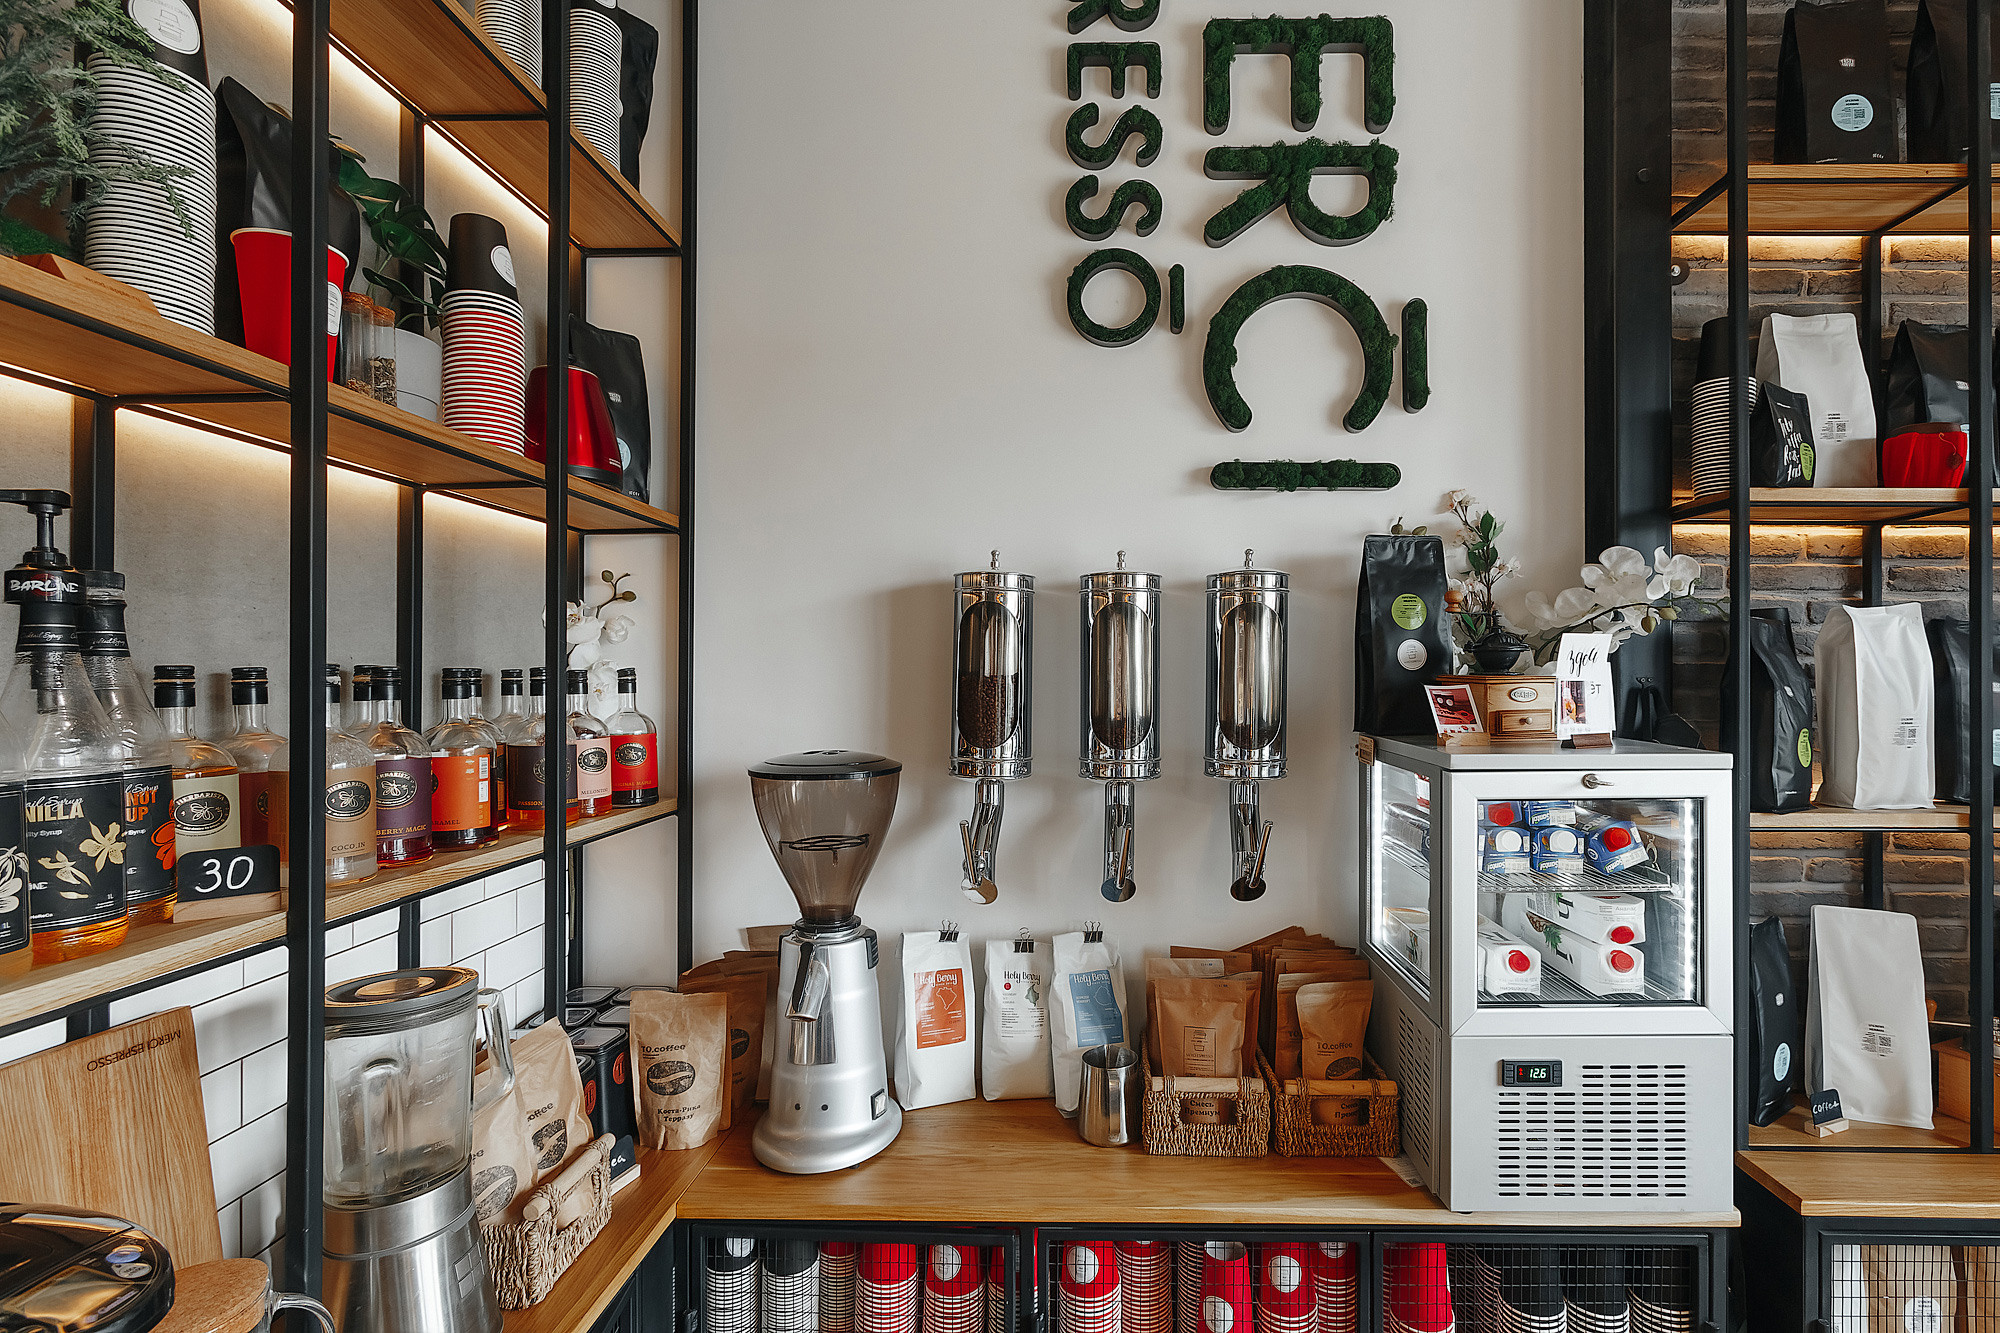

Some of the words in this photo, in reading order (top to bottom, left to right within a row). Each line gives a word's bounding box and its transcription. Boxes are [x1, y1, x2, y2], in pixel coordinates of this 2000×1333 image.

[10, 577, 79, 593] BARLINE
[376, 827, 405, 836] BERRY
[405, 824, 427, 833] MAGIC
[194, 854, 255, 893] 30
[936, 973, 957, 985] Berry
[1004, 971, 1021, 984] Holy
[1022, 971, 1041, 985] Berry
[1073, 974, 1091, 987] Holy
[147, 1029, 181, 1051] MERCI
[86, 1042, 146, 1072] ESPRESSO
[1530, 1068, 1547, 1079] 12.6
[525, 1101, 553, 1121] offee
[1812, 1101, 1840, 1115] Coffee
